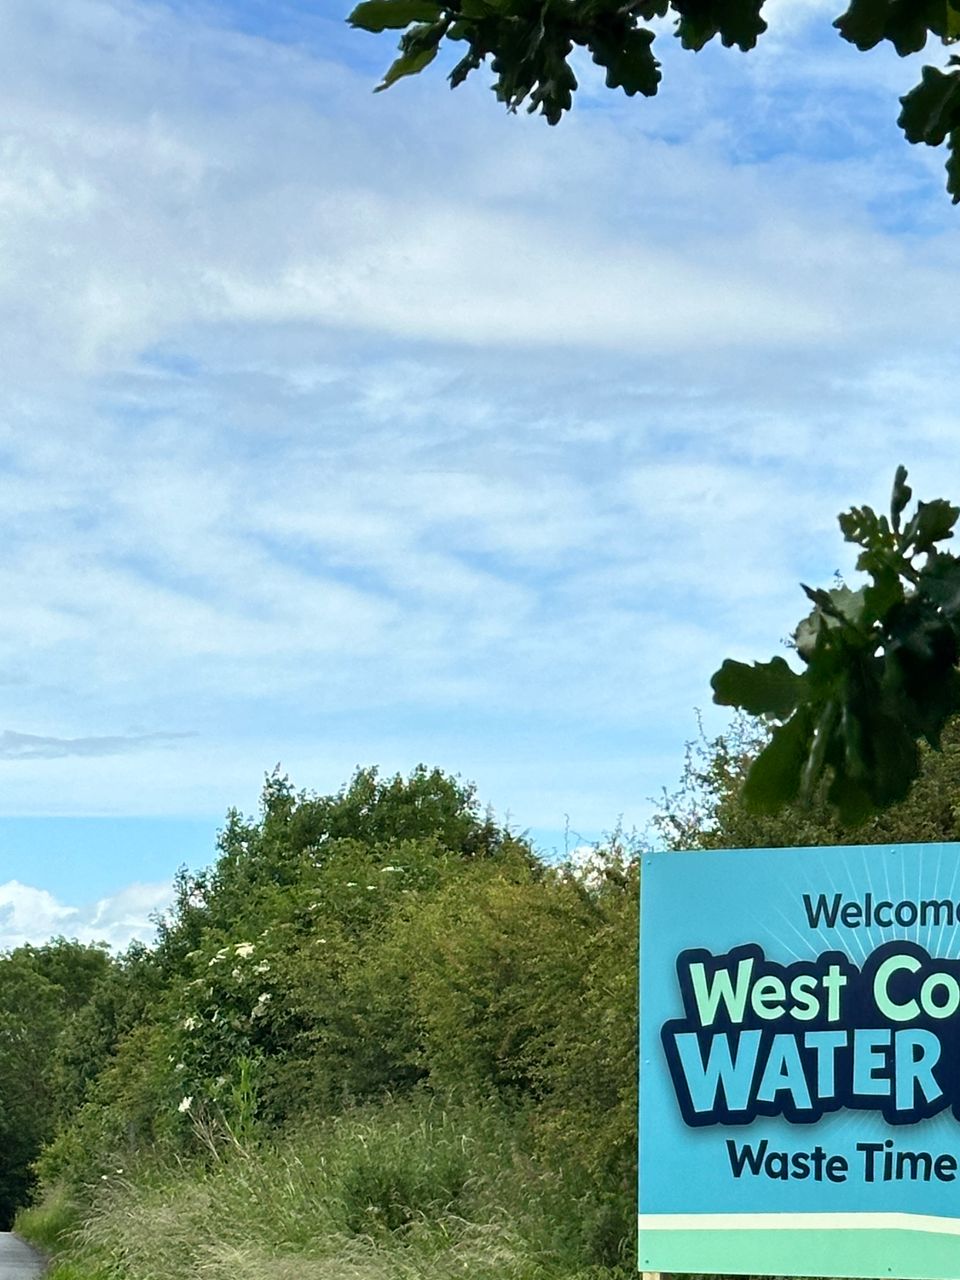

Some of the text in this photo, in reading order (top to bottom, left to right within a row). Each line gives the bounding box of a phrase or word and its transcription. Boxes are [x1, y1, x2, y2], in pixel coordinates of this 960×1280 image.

[689, 957, 847, 1026] West
[673, 1028, 943, 1113] WATER
[726, 1139, 848, 1182] Waste
[857, 1140, 957, 1182] Time
